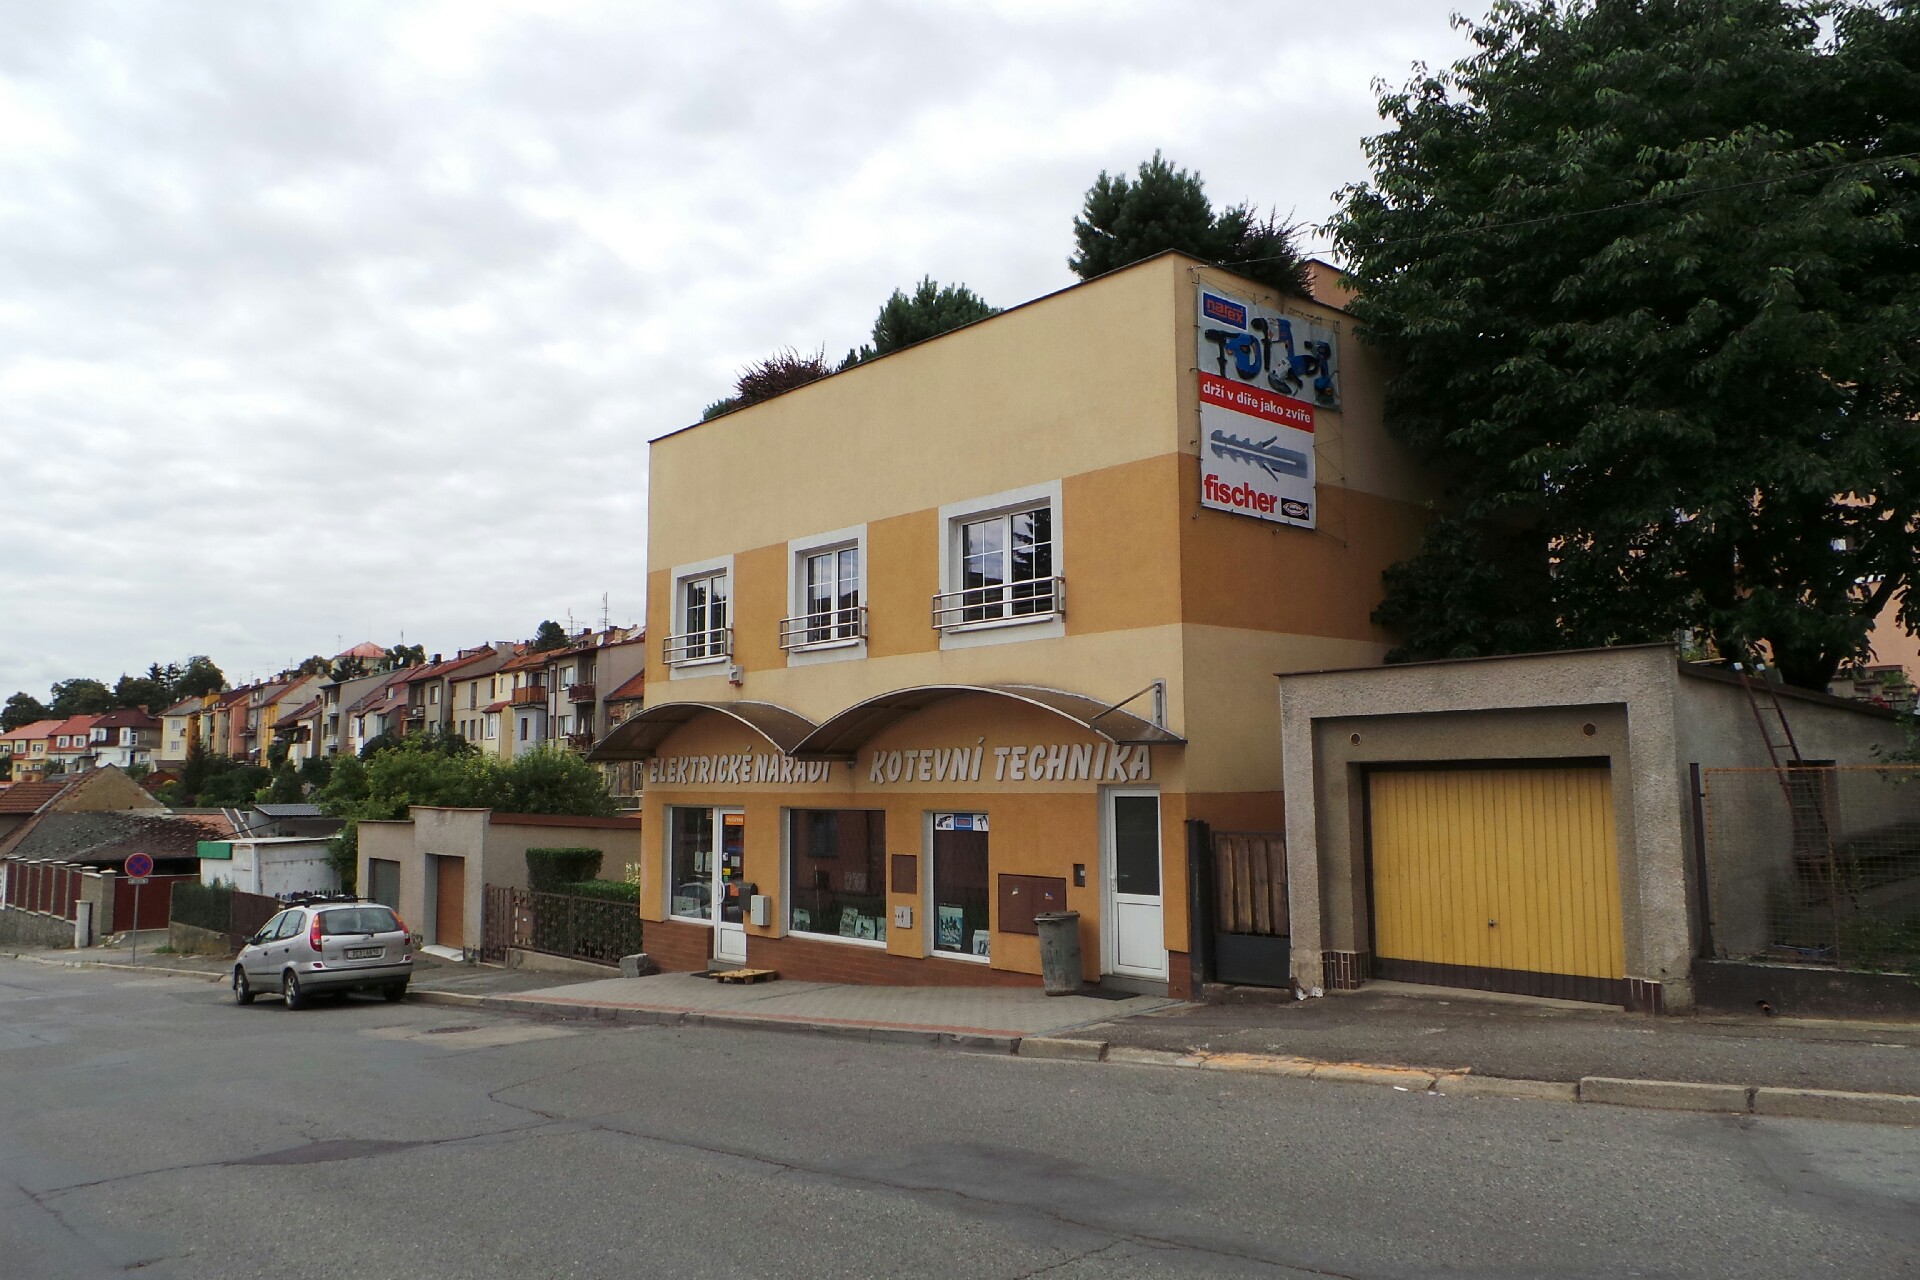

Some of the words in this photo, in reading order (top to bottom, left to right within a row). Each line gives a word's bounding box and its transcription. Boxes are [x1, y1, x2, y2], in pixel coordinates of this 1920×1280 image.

[1207, 299, 1244, 323] narex
[1203, 381, 1224, 398] drží
[1227, 391, 1234, 400] v
[1237, 392, 1258, 408] díře
[1260, 398, 1284, 415] jako
[1286, 408, 1311, 423] zvíře
[1204, 474, 1278, 513] fischer
[650, 746, 753, 784] ELEKTRICKÉ
[869, 737, 985, 784] KOTEVNÍ
[994, 742, 1151, 783] TECHNIKA
